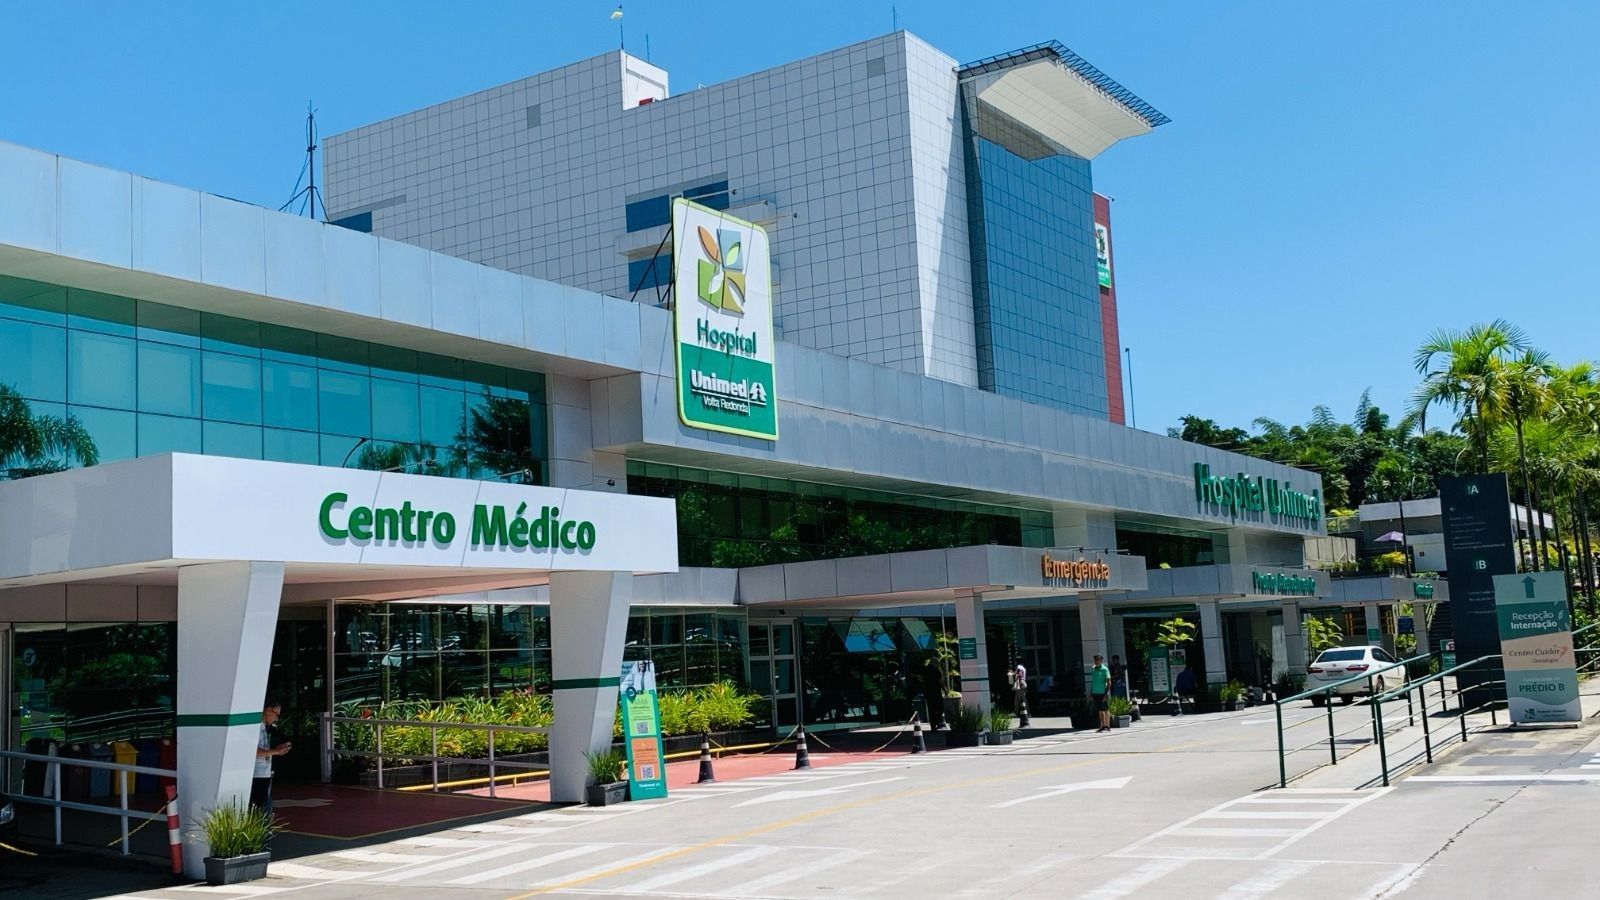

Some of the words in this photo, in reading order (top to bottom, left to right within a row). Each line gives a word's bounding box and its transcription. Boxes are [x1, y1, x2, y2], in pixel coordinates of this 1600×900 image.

[697, 318, 757, 355] Hospital
[691, 369, 748, 398] Unimed
[703, 395, 720, 407] Volta
[721, 398, 749, 413] Redonda
[1194, 462, 1265, 515] Hospital
[1266, 478, 1322, 522] Unimed
[319, 492, 456, 544] Centro
[471, 501, 596, 550] Médico
[1041, 553, 1110, 583] Emergência
[1510, 620, 1558, 630] Internação
[1512, 610, 1554, 621] Recepção
[1509, 649, 1534, 657] Centro
[1534, 647, 1560, 656] Cuidar
[1519, 681, 1556, 693] PRÉDIO
[1558, 683, 1566, 692] B
